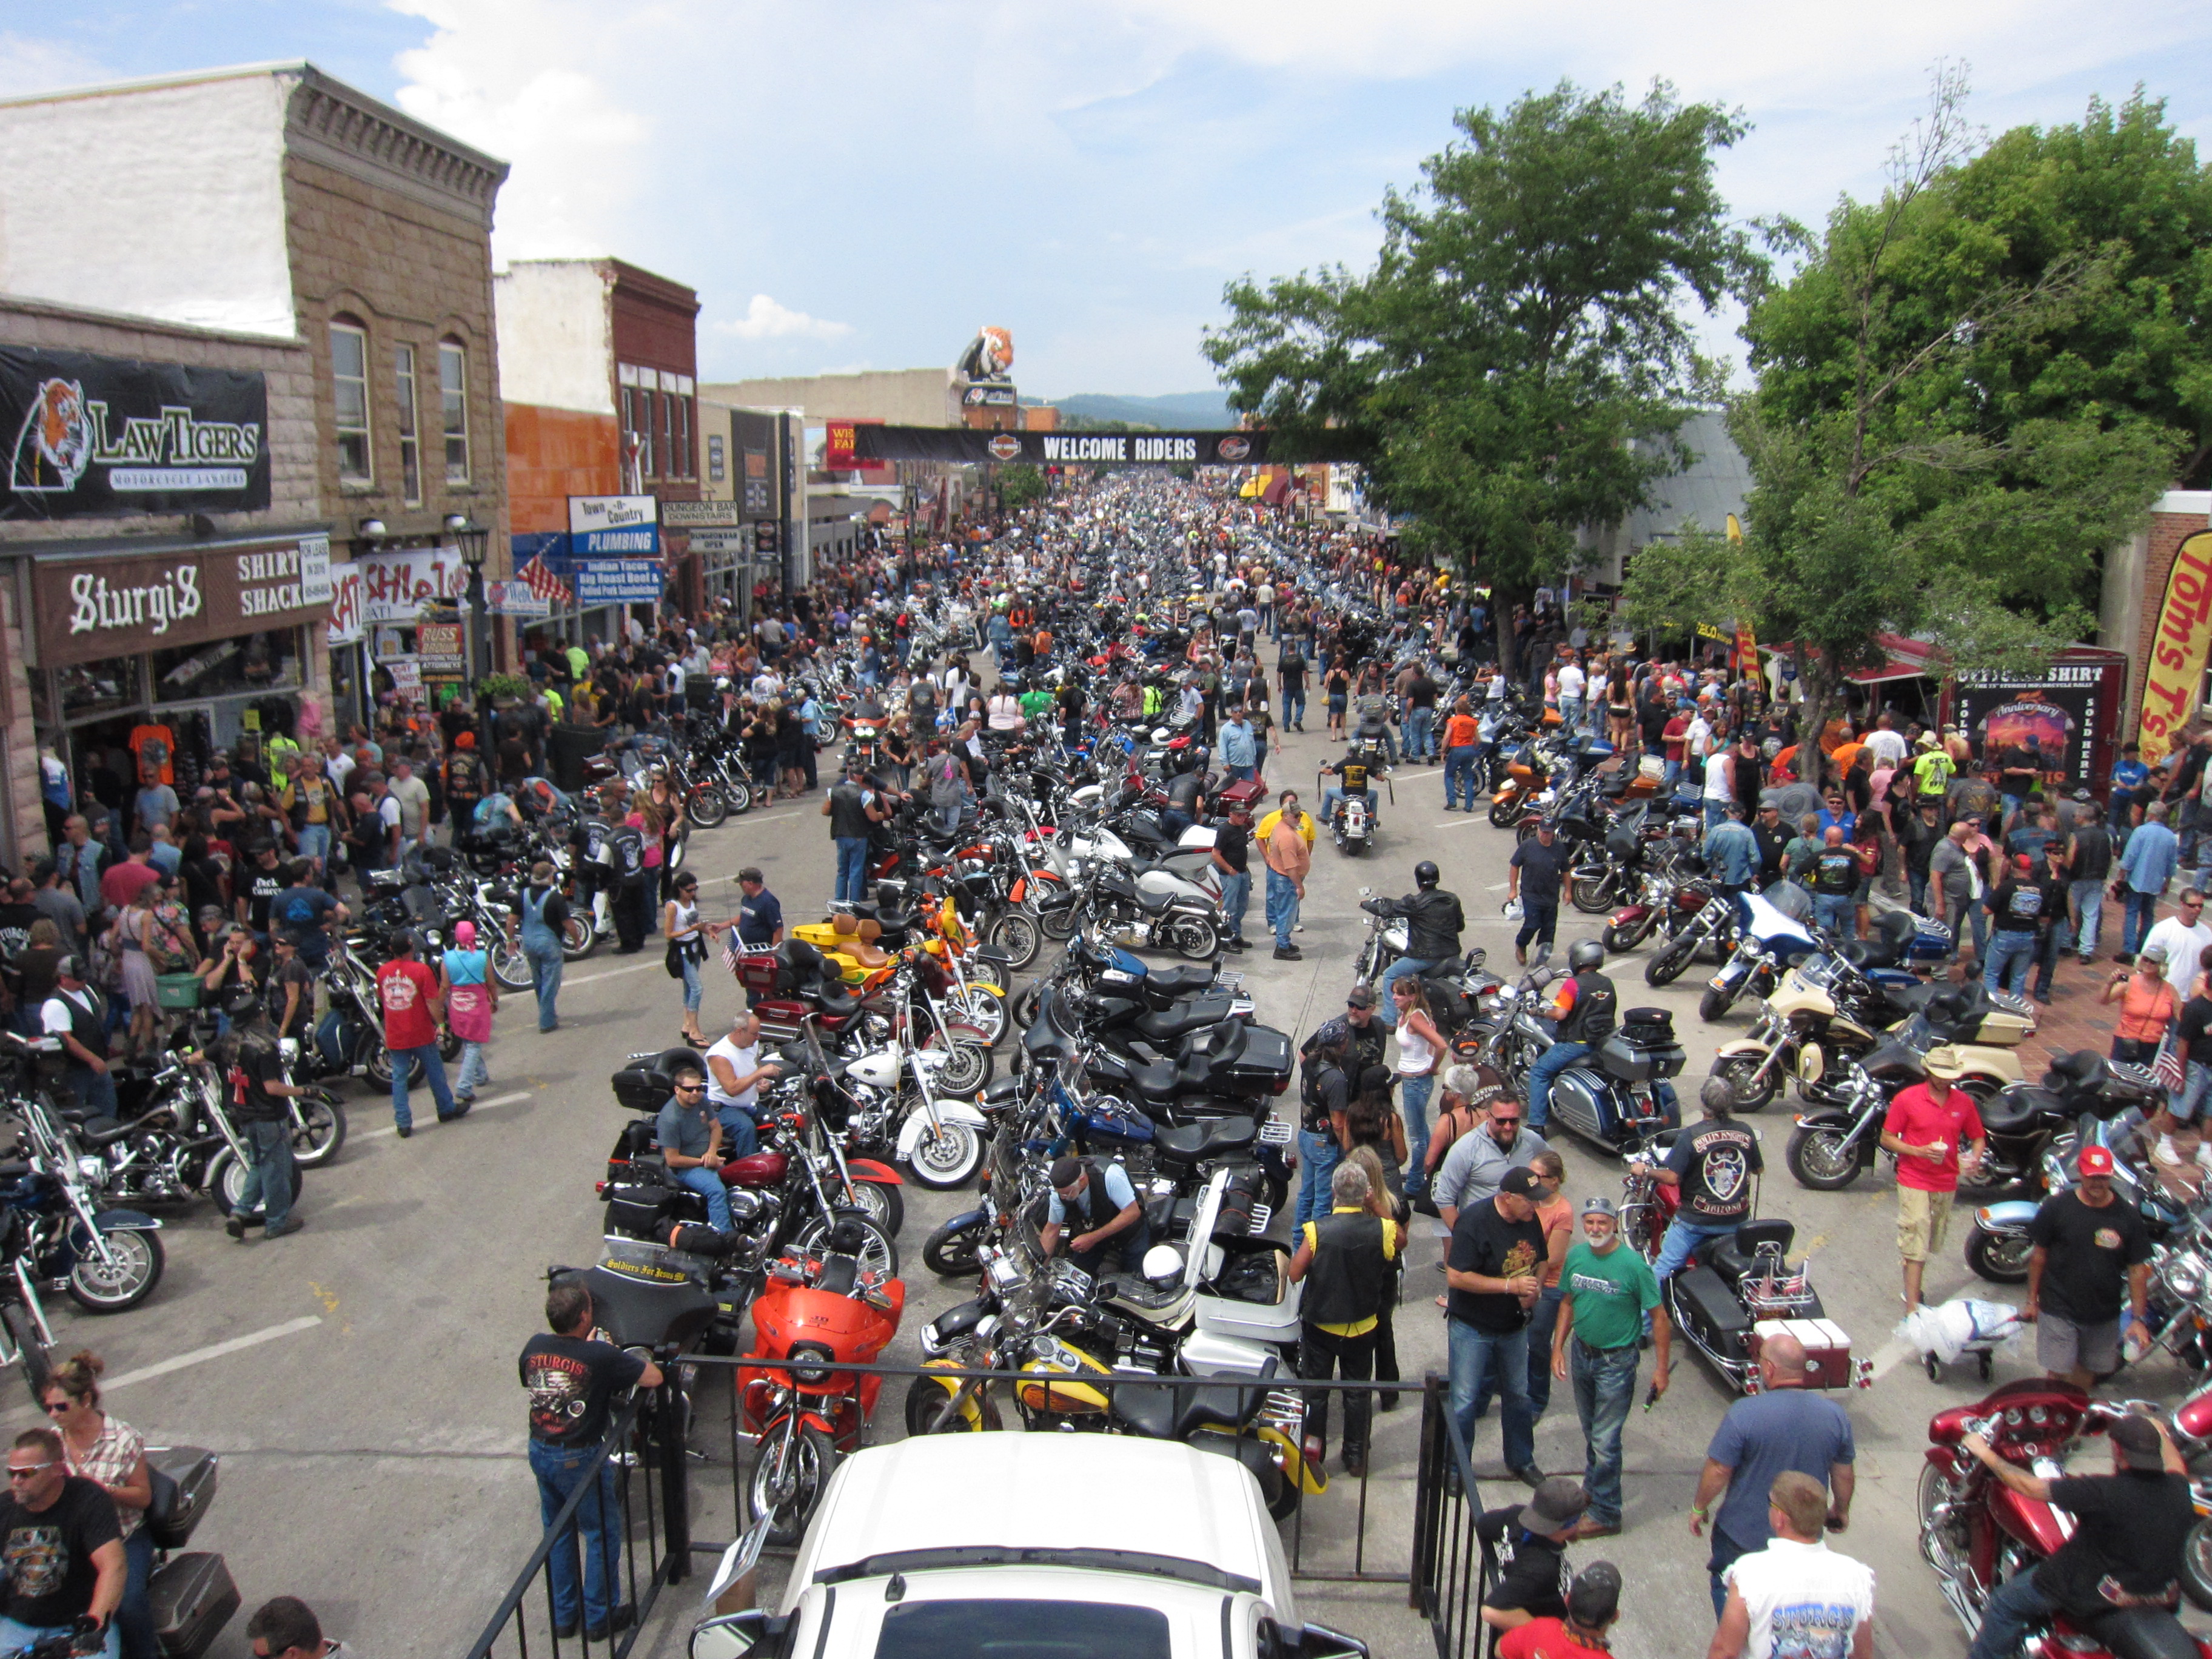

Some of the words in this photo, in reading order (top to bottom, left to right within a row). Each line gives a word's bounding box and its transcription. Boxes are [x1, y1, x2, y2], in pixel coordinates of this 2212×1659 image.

[1044, 436, 1127, 460] WELCOME
[1135, 437, 1196, 460] RIDERS
[581, 502, 605, 515] Town
[664, 503, 712, 512] DUNGEON
[717, 503, 736, 511] BAR
[607, 509, 643, 523] Country
[669, 512, 732, 520] DOWNSTAIRS
[588, 531, 652, 551] PLUMBING
[237, 549, 300, 582] SHIRT
[241, 583, 303, 617] SHACK
[421, 627, 458, 642] RUSS
[421, 642, 460, 654] BROWN
[2047, 666, 2103, 682] SHIRT
[1995, 702, 2060, 718] Anniversary
[1959, 699, 1969, 739] SOLD
[607, 1258, 639, 1273] Soldiers
[640, 1265, 654, 1276] For
[654, 1267, 674, 1280] Jesus
[530, 1354, 585, 1375] STURGIS
